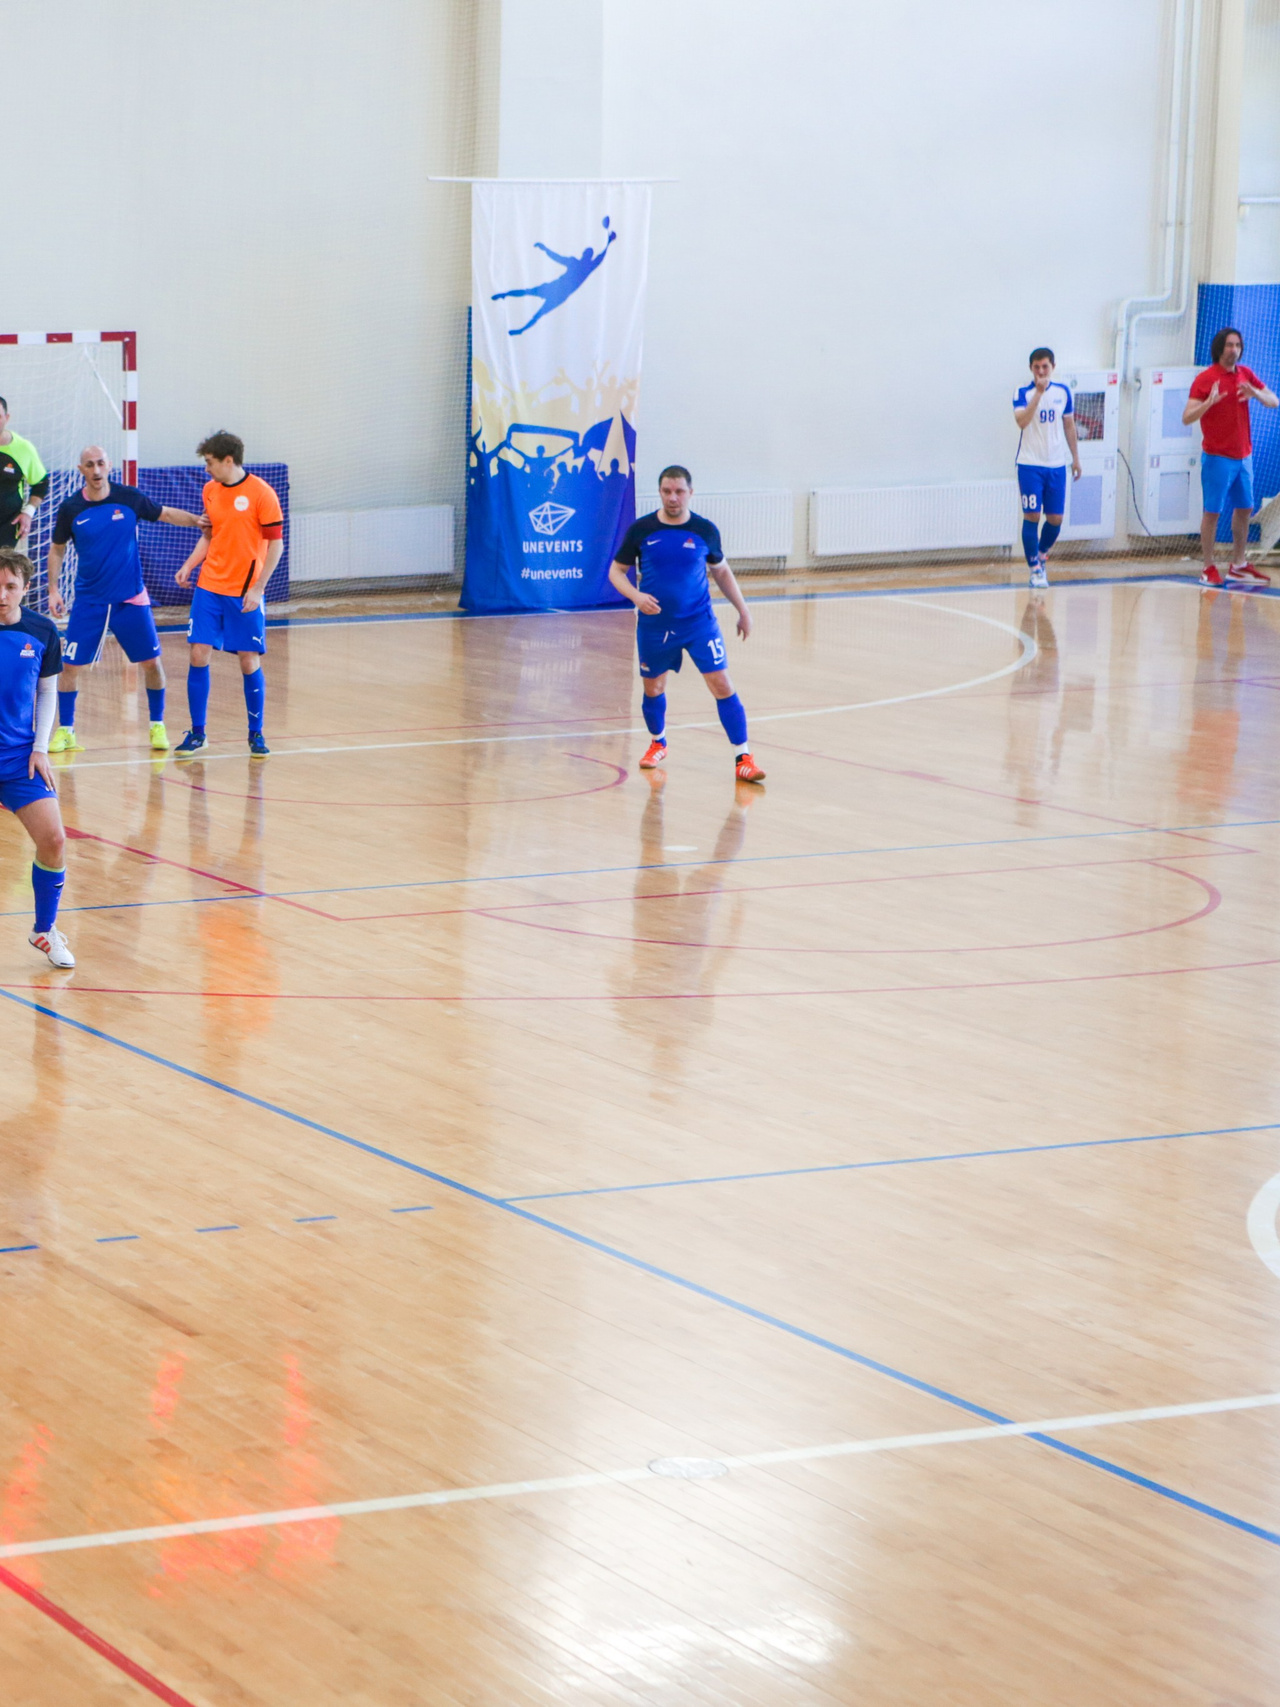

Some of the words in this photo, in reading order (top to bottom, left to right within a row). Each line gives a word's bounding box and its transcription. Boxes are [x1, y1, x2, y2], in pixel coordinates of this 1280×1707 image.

[1039, 409, 1055, 424] 98
[522, 540, 583, 554] UNEVENTS
[520, 566, 583, 580] #unevents
[707, 638, 725, 659] 15
